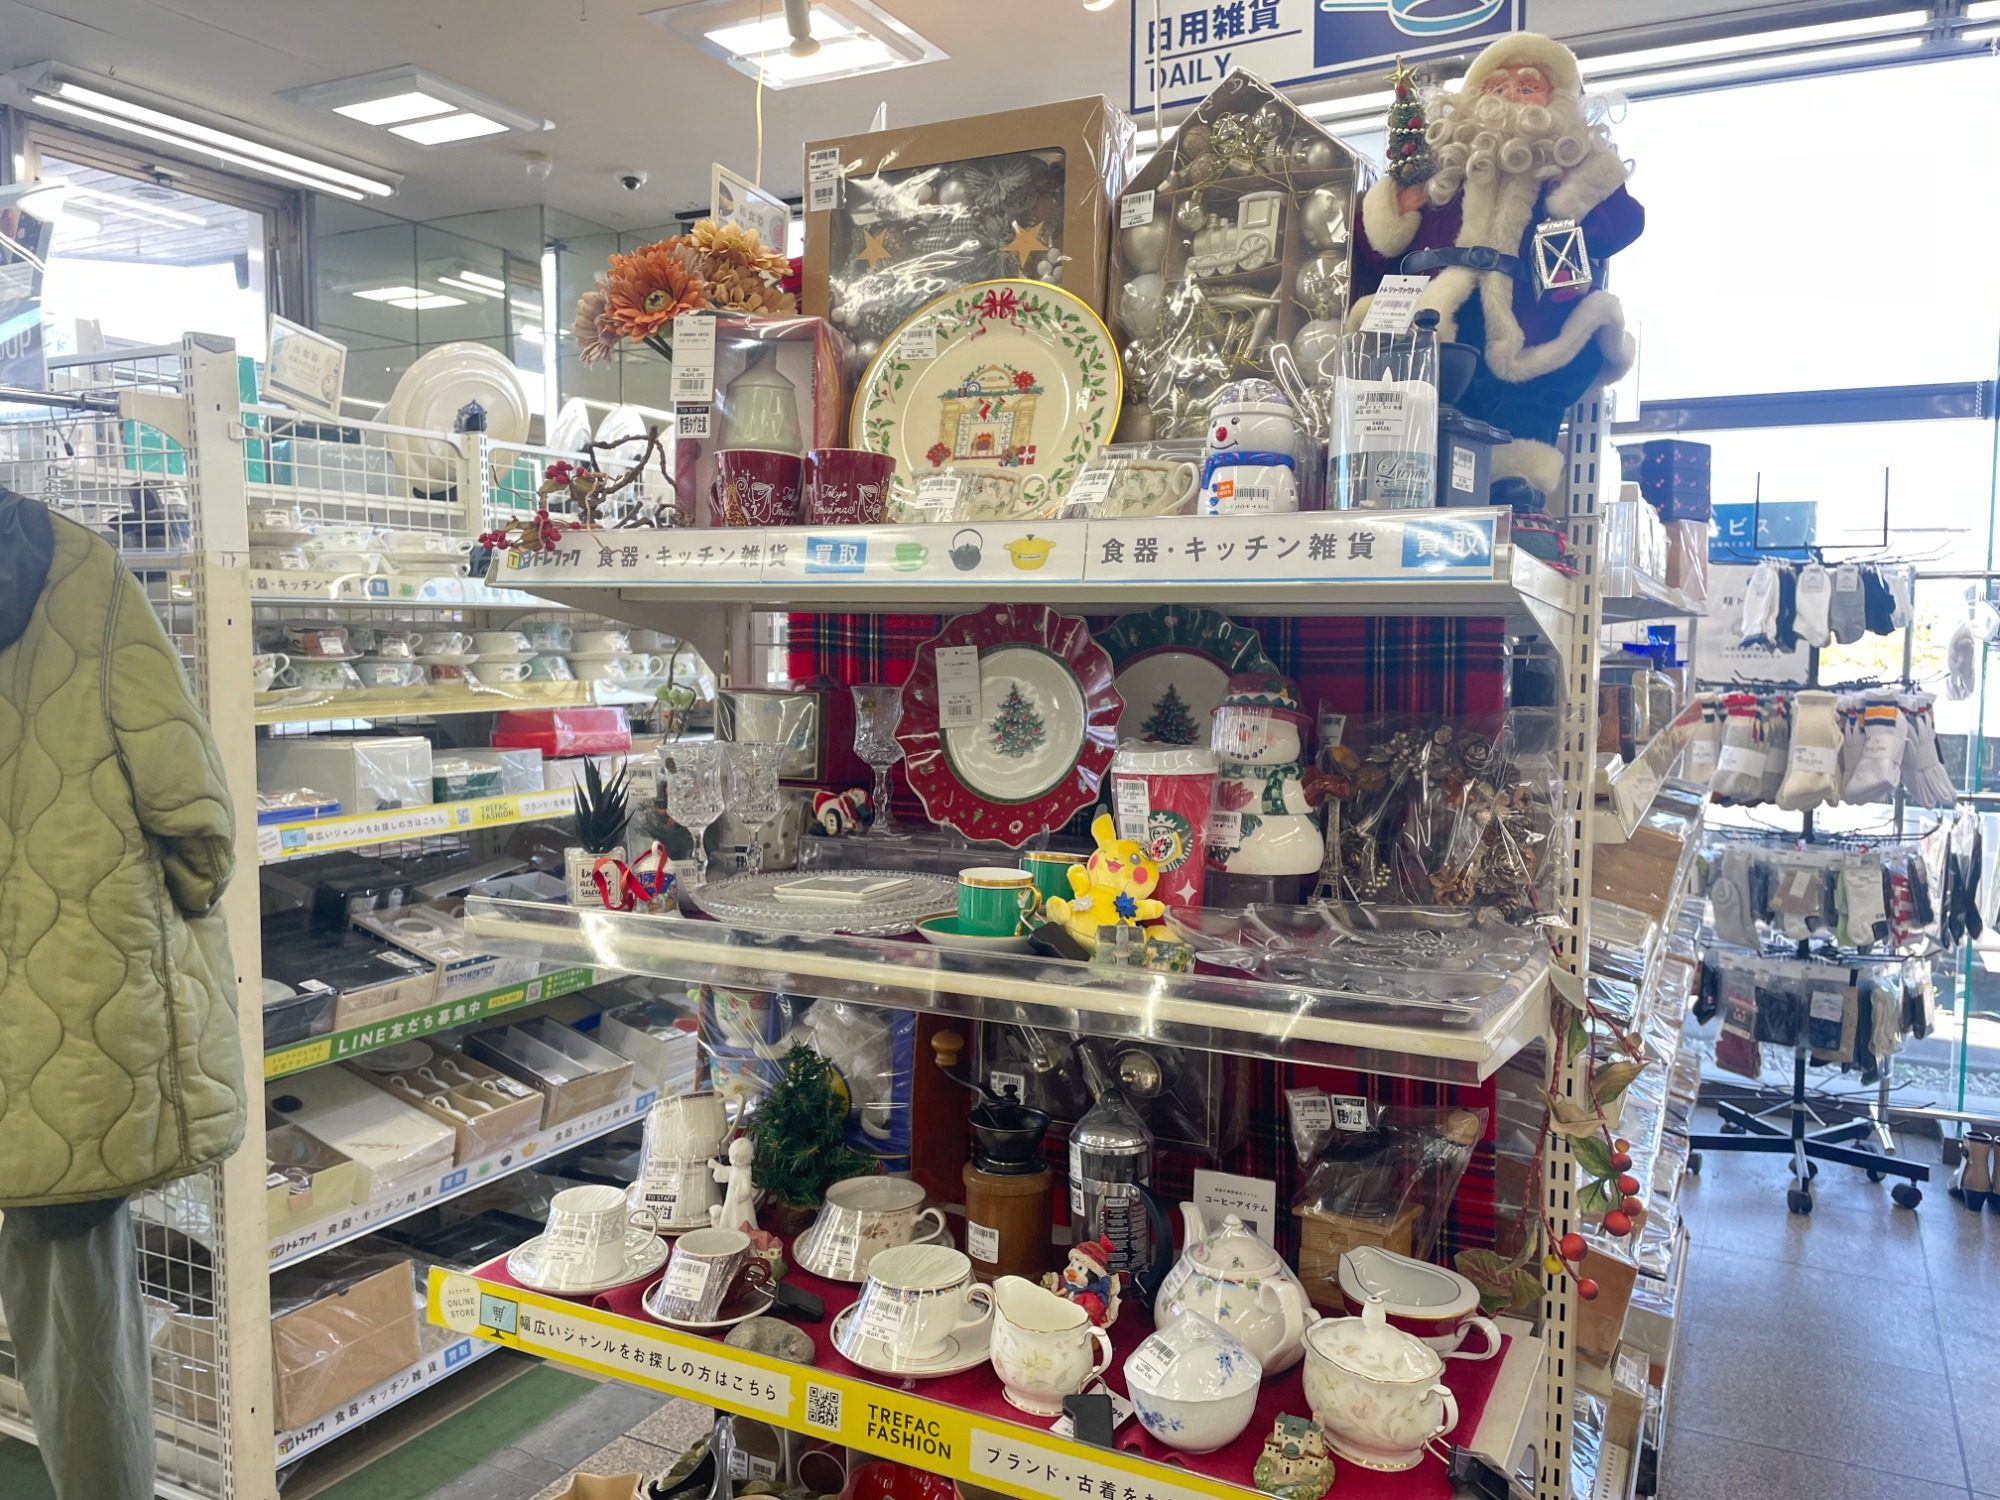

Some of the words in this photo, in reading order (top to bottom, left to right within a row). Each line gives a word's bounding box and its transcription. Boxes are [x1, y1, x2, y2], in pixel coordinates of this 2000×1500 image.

[1147, 0, 1281, 53] 日用雑貨
[1149, 52, 1231, 91] DAILY
[533, 549, 582, 567] トレファク
[596, 544, 787, 568] 食器・キッチン雑貨
[815, 544, 859, 566] 買取
[1101, 531, 1375, 564] 食器・キッチン雑貨
[1415, 530, 1482, 559] 買取
[480, 802, 510, 813] TREFAC
[481, 809, 514, 821] FASHION
[306, 815, 445, 842] 幅広いジャンルをお探しの方はこちら
[337, 1000, 482, 1055] LINE友だち募集中
[554, 1104, 631, 1143] 食器・キッチン雑貨
[285, 1231, 318, 1252] トレファク
[326, 1185, 433, 1237] 食器・キッチン雑貨
[1204, 1195, 1268, 1213] コーヒーアイテム
[447, 1297, 476, 1308] ONLINE
[450, 1307, 476, 1318] STORE
[519, 1313, 777, 1402] 幅広いジャンルをお探しの方はこちら
[295, 1420, 326, 1445] トレファク
[334, 1359, 437, 1426] 食器・キッチン雑貨
[447, 1342, 469, 1363] 買取
[867, 1403, 940, 1438] TREFAC
[867, 1423, 952, 1460] FASHION
